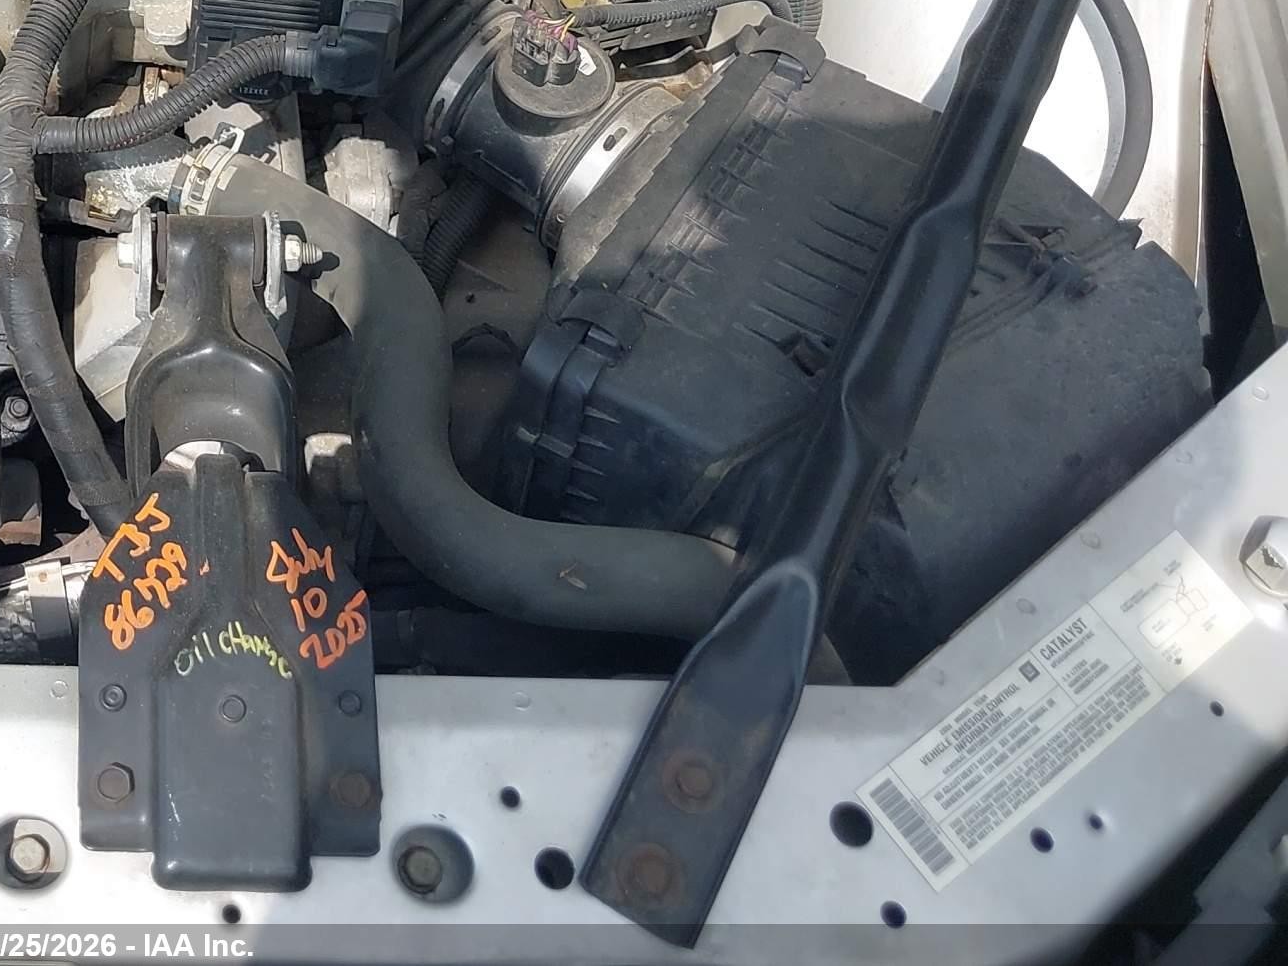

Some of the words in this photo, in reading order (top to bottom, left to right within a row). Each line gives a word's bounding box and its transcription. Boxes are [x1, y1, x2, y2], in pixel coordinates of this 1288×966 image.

[290, 586, 328, 633] 10
[1038, 616, 1089, 661] CATALYST
[919, 736, 952, 766] VEHICLE
[950, 707, 988, 741] EMISSION
[984, 681, 1020, 712] CONTROL
[953, 708, 1005, 753] INFORMATION
